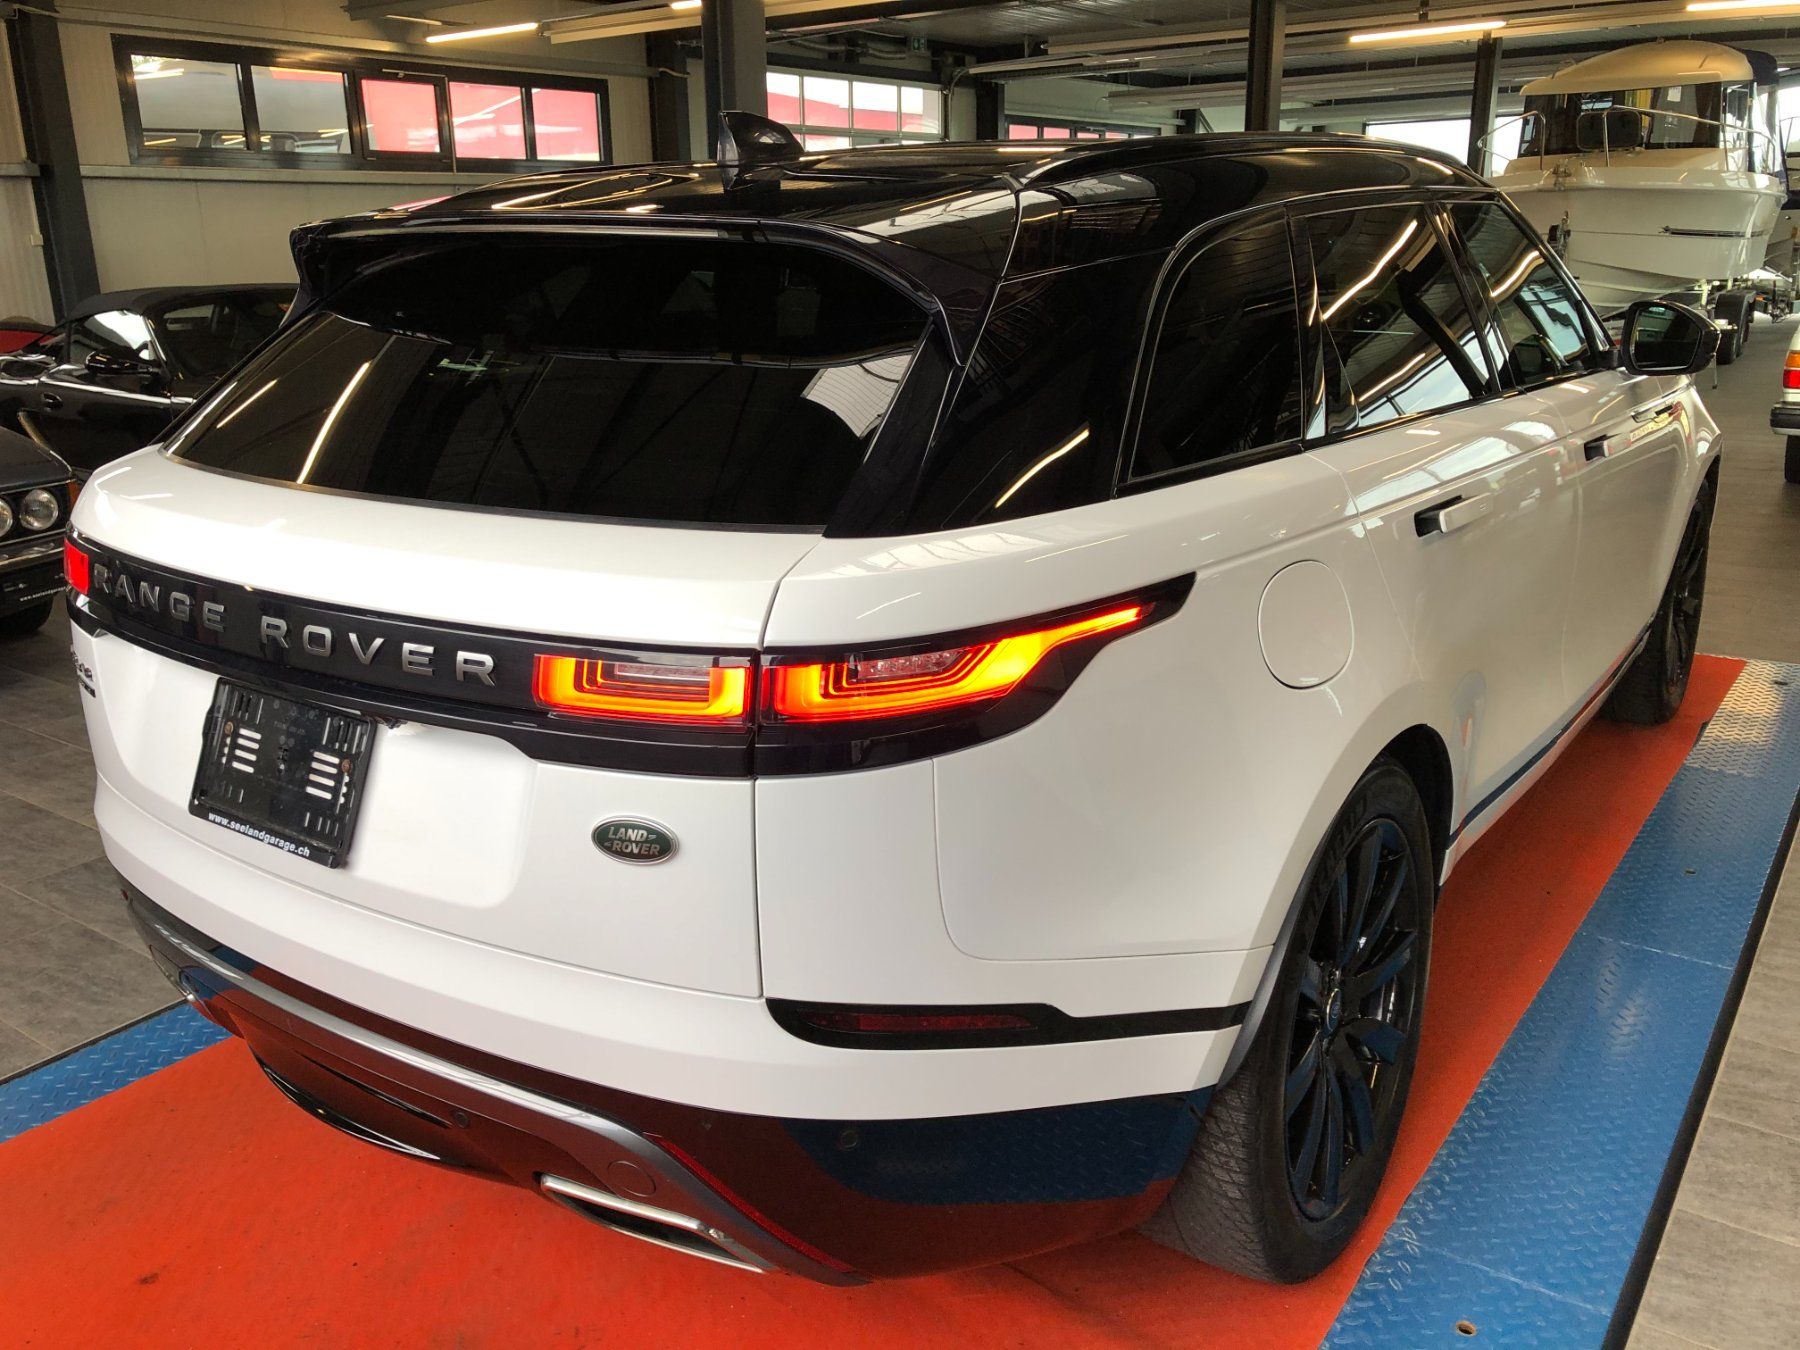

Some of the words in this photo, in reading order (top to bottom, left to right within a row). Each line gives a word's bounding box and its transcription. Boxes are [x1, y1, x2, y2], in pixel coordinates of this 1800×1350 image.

[93, 563, 225, 633] RANGE
[260, 615, 496, 687] ROVER
[208, 812, 311, 857] www.seelandgarage.ch
[608, 826, 648, 842] LAND
[611, 840, 661, 856] ROVER
